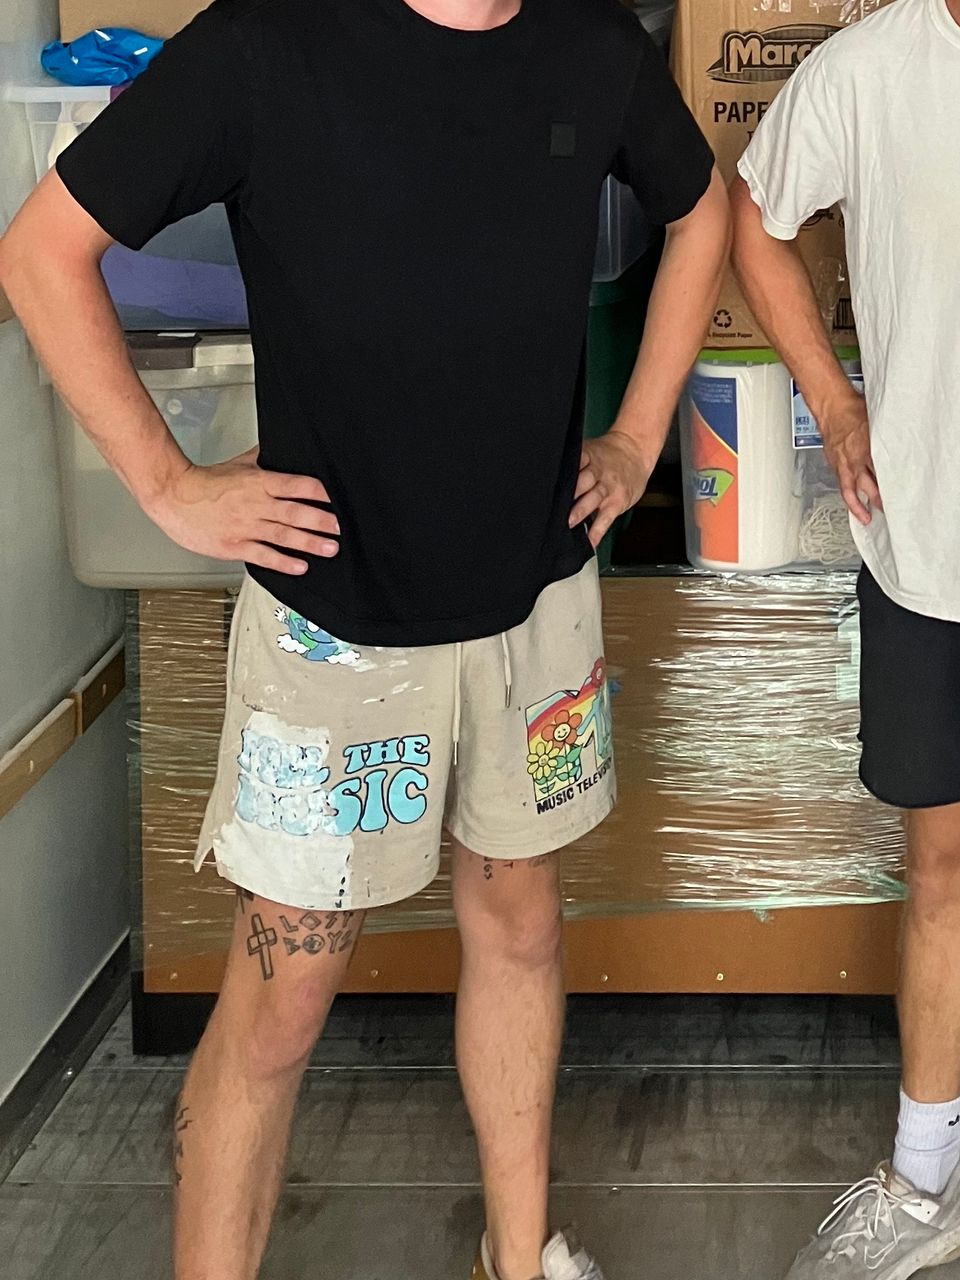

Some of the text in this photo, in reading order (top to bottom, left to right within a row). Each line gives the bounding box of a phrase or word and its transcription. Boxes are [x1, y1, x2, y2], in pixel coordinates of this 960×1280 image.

[723, 32, 820, 72] Marc
[714, 102, 769, 123] PAPE
[343, 734, 430, 774] THE
[536, 786, 575, 815] MUSIC
